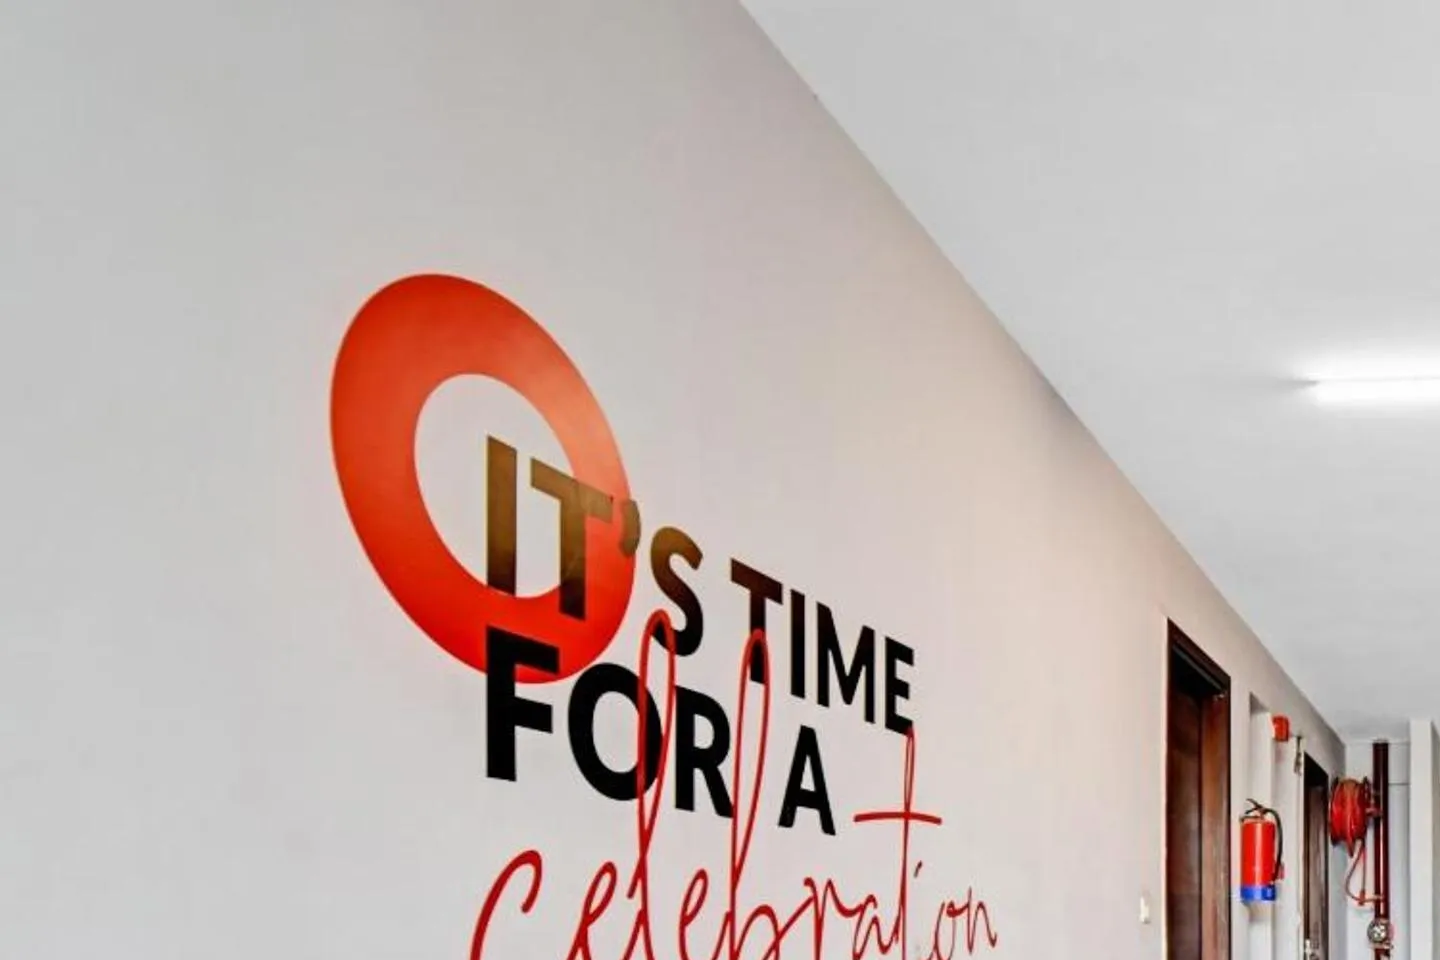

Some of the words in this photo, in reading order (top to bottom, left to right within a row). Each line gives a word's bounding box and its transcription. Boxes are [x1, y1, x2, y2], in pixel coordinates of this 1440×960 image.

[485, 625, 733, 818] FOR
[778, 724, 836, 836] A
[730, 558, 914, 734] TIME
